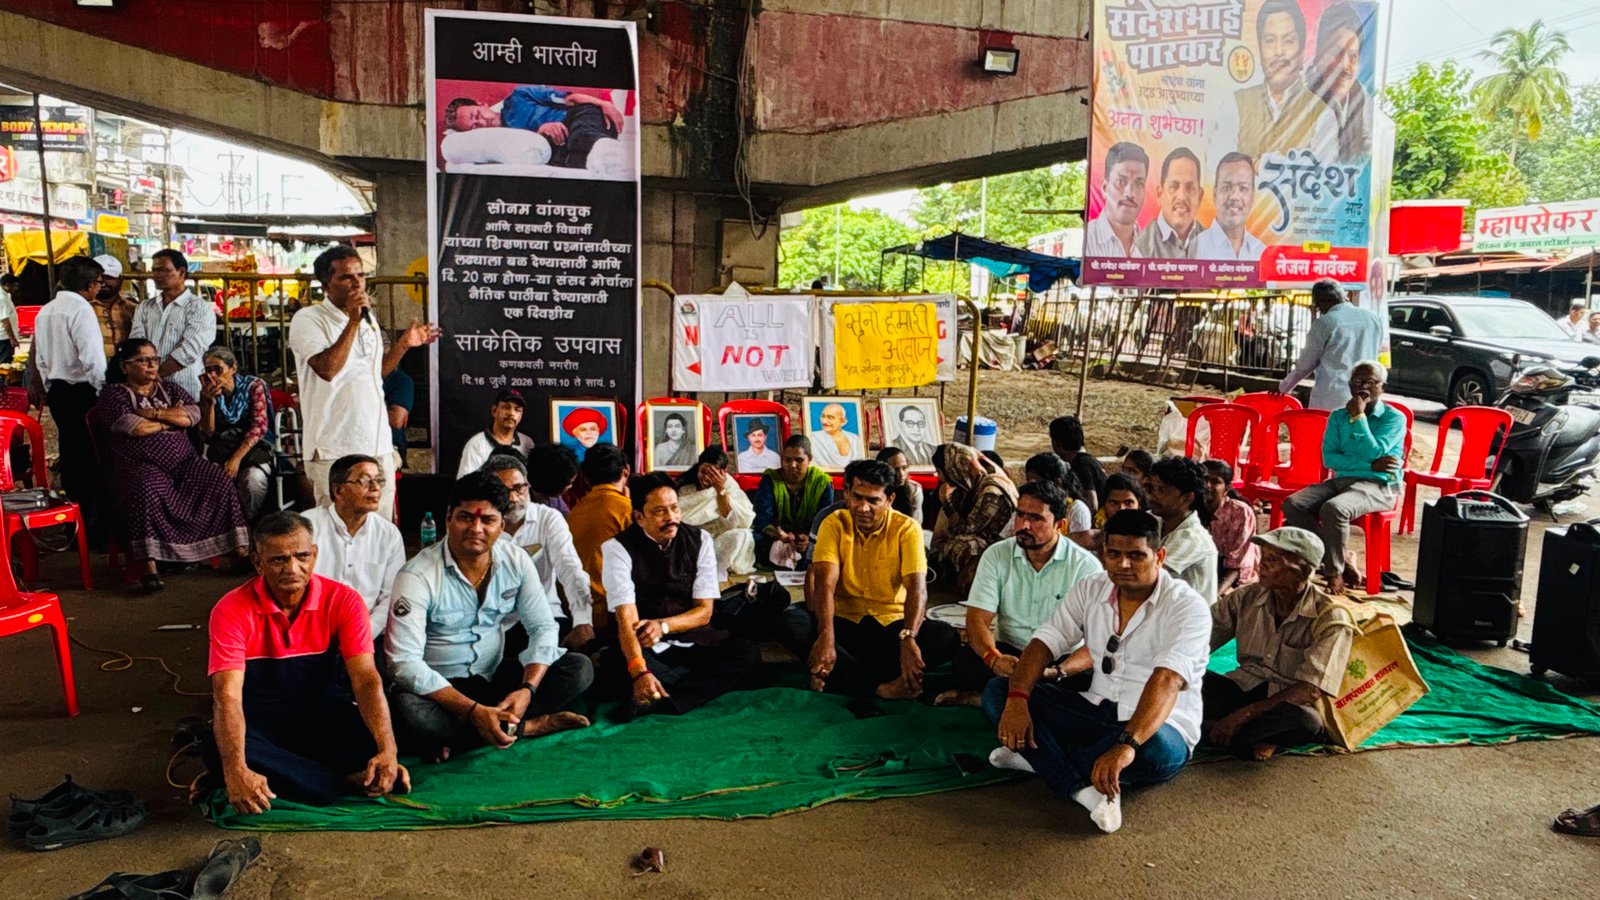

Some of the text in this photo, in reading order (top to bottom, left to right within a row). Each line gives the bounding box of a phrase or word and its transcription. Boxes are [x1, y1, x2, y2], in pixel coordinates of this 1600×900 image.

[472, 37, 598, 68] आम्ही भारतीय
[1, 121, 34, 132] BODY
[1108, 105, 1143, 131] अनंत
[487, 199, 591, 222] सोनम वांगचुक
[485, 220, 511, 232] आणि
[515, 222, 553, 234] सहकारी
[443, 233, 482, 248] यांच्या
[486, 235, 549, 250] शिक्षणाच्या
[455, 254, 622, 270] लढ्याला बळ देण्यासाठी आणि
[1276, 253, 1309, 275] तेजस
[442, 268, 457, 283] दि.
[463, 271, 479, 283] 20
[483, 272, 499, 284] ला
[556, 272, 587, 287] संसद
[590, 273, 634, 288] मोर्चाला
[468, 286, 506, 301] नैतिक
[552, 288, 609, 304] देण्यासाठी
[503, 307, 524, 319] एक
[714, 304, 784, 328] ALL
[845, 305, 882, 344] सुनो
[885, 303, 931, 337] हमारी
[454, 328, 622, 355] सांकेतिक उपवास
[744, 329, 759, 340] IS
[499, 358, 579, 371] कणकवली नगरीत
[721, 345, 790, 367] NOT
[489, 374, 506, 389] जुलै
[511, 377, 533, 387] 2026
[574, 376, 582, 387] ते
[609, 379, 616, 387] 5
[762, 369, 810, 383] WELL
